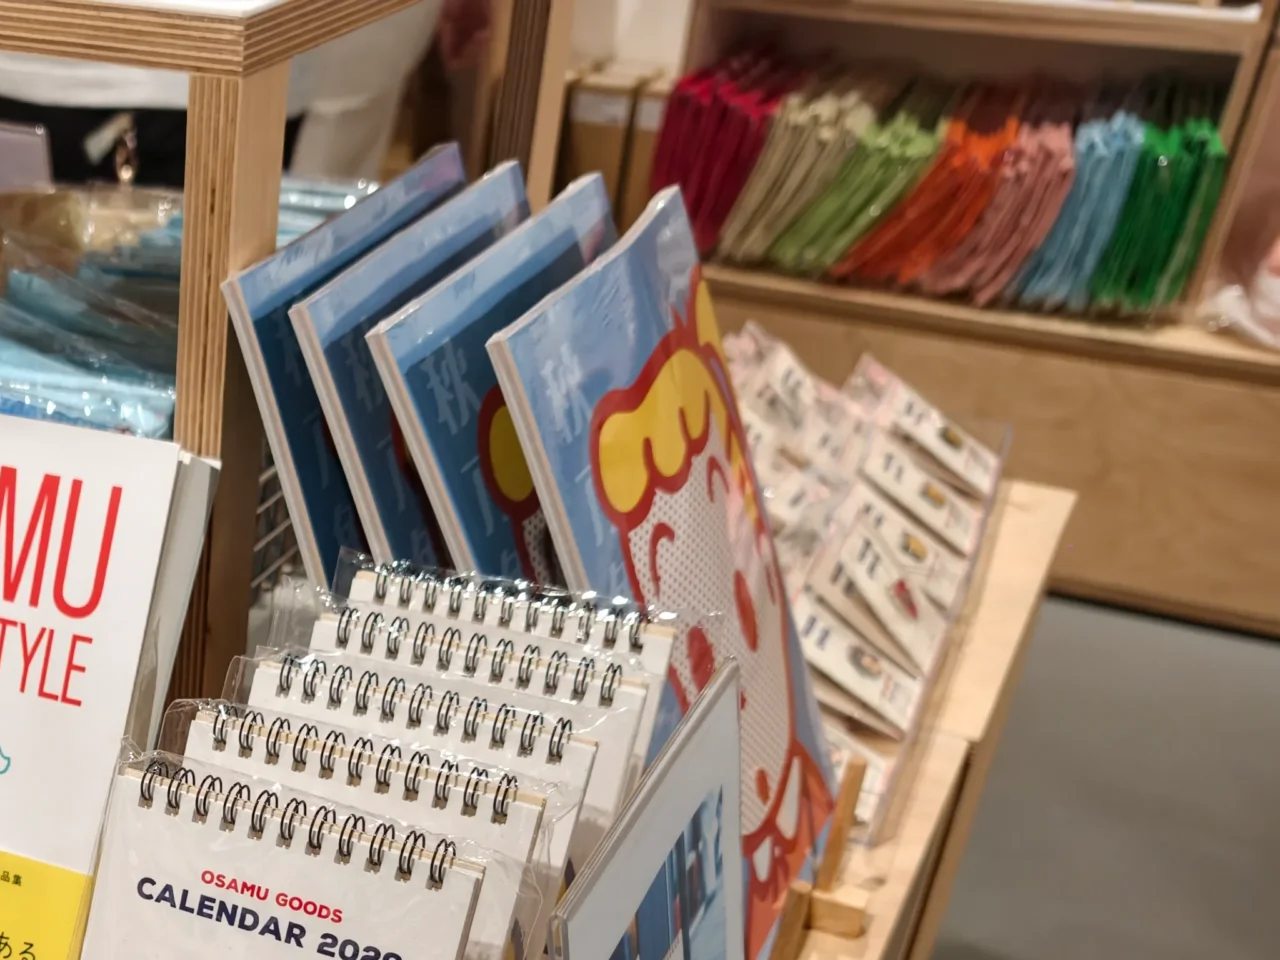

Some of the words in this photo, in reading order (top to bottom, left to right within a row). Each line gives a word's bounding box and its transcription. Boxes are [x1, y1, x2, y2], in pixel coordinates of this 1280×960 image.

[137, 876, 307, 949] CALENDAR
[201, 869, 270, 902] OSAMU
[275, 892, 344, 924] GOODS
